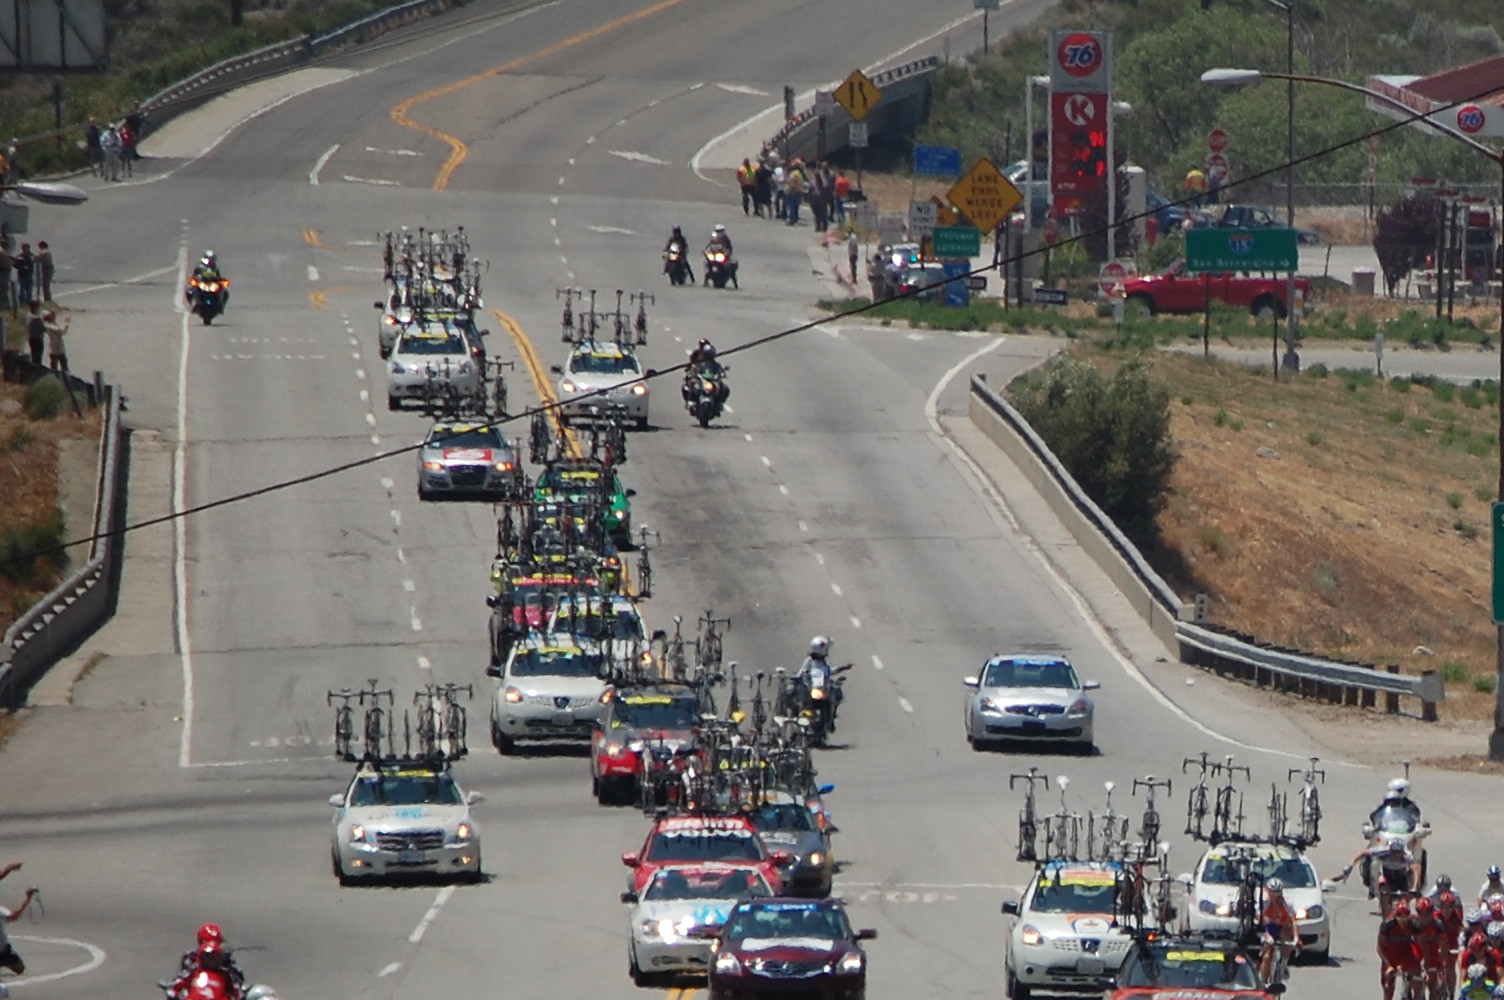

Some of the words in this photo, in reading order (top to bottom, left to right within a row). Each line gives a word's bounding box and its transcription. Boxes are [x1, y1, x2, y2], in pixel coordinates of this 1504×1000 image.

[1064, 42, 1095, 67] 76
[1064, 94, 1094, 126] K
[1459, 110, 1481, 128] 76
[971, 174, 998, 183] LANE
[971, 186, 999, 195] ENDS
[966, 197, 1002, 208] MERGE
[663, 829, 753, 838] VOLVO
